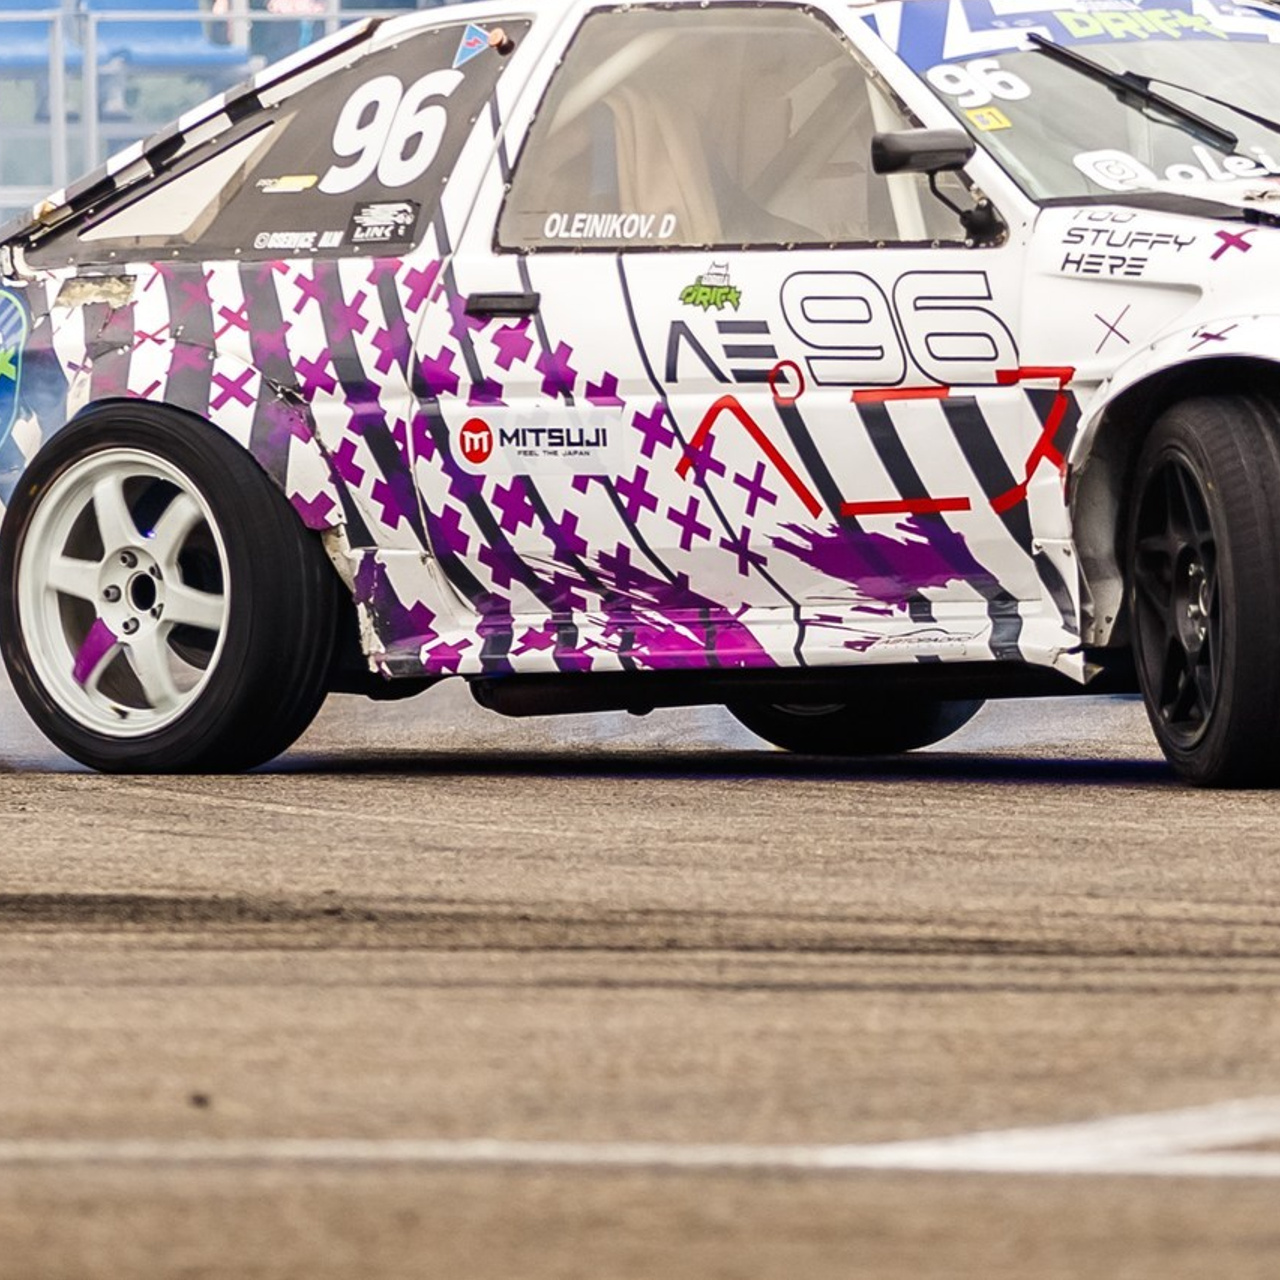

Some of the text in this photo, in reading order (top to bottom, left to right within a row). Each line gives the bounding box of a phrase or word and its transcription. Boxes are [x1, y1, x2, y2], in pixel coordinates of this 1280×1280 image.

[925, 58, 1032, 108] 96
[317, 68, 465, 195] 96
[543, 212, 677, 239] OLEINIKOV. D
[1061, 226, 1197, 252] STUFFY
[1060, 252, 1148, 276] HERE
[499, 427, 608, 447] MITSUJI
